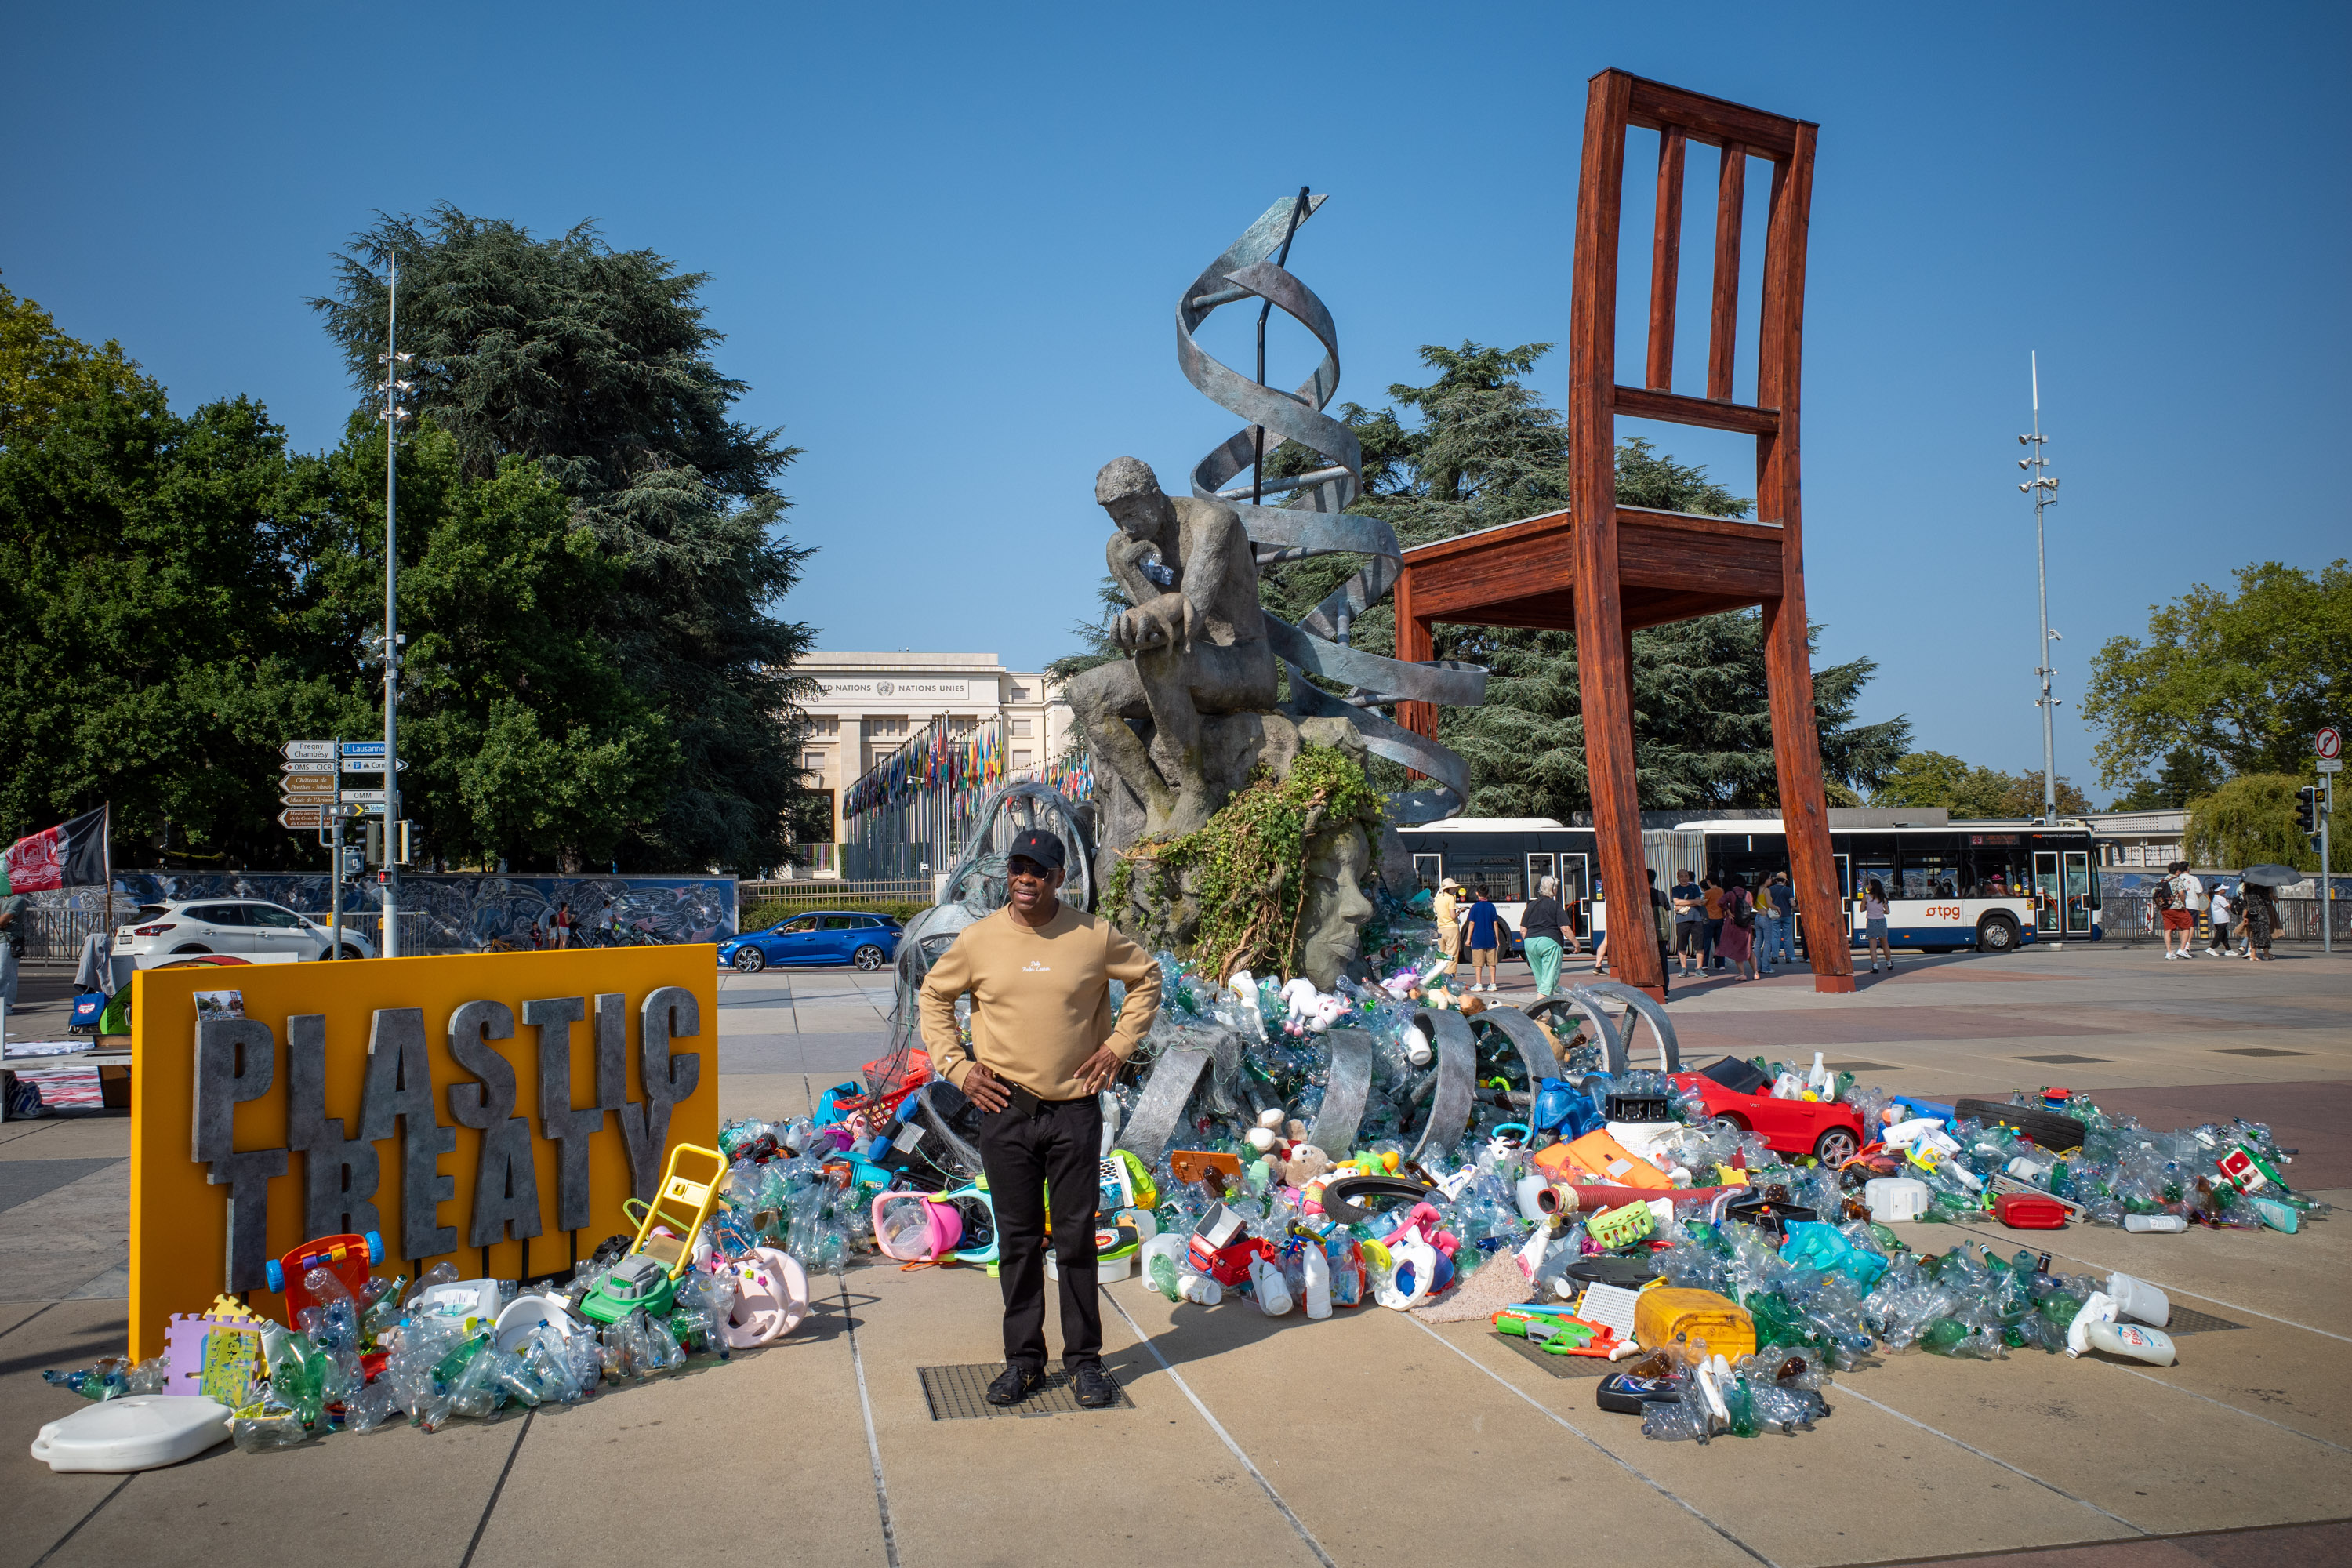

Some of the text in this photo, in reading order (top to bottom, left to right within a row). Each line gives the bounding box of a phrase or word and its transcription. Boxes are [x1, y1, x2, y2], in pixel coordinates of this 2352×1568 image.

[1972, 835, 1983, 844] 29
[192, 986, 699, 1163] PLASTIC
[207, 1100, 673, 1294] TREATY
